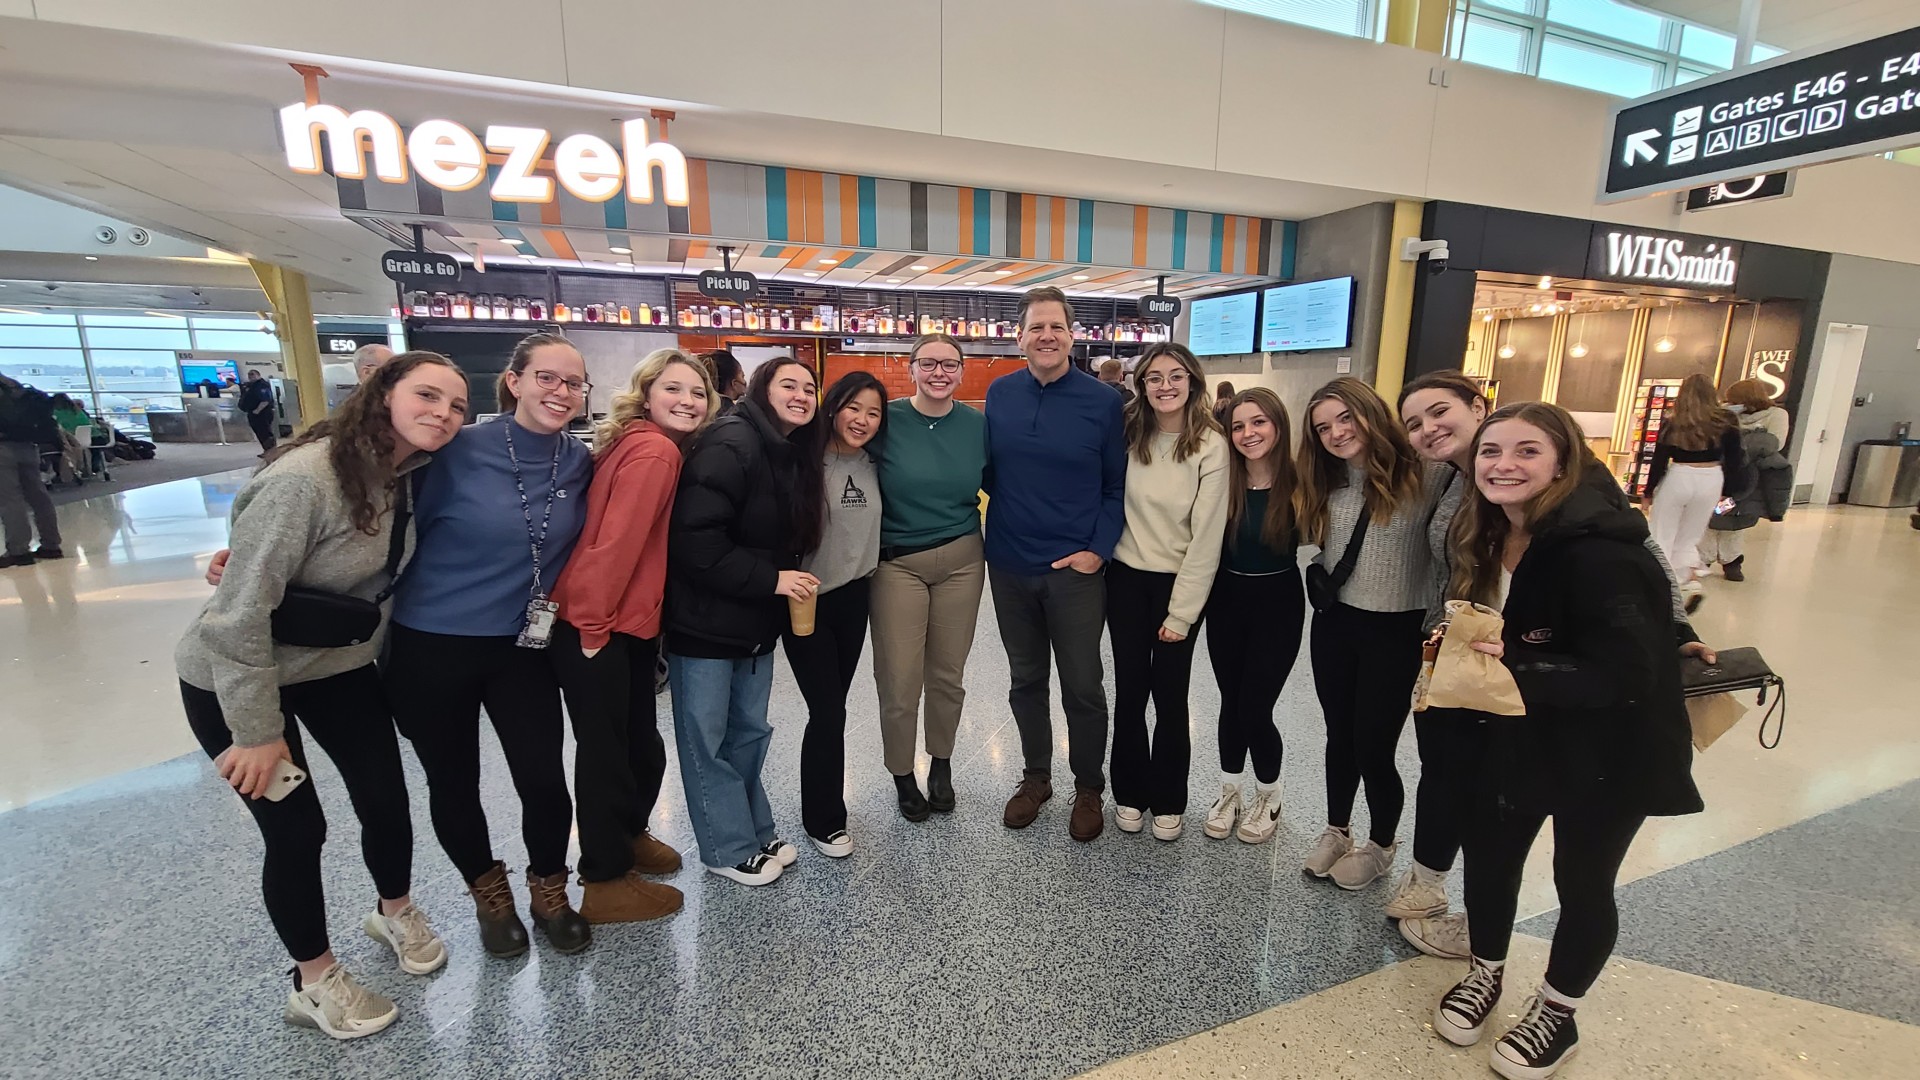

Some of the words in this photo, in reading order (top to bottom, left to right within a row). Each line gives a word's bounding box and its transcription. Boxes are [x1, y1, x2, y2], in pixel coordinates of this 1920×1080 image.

[1709, 92, 1785, 124] Gates
[1792, 71, 1847, 104] E46
[1708, 131, 1729, 153] A
[1744, 123, 1762, 145] B
[1779, 114, 1799, 136] C
[1813, 106, 1838, 130] D
[280, 102, 690, 206] mezeh
[386, 259, 421, 274] Grab
[423, 263, 434, 275] &
[436, 262, 455, 276] Go
[1608, 232, 1736, 286] WHSmith
[706, 276, 733, 290] Pick
[734, 277, 750, 292] Up
[1149, 300, 1175, 312] Order
[330, 339, 357, 351] E50
[1761, 349, 1792, 361] WH
